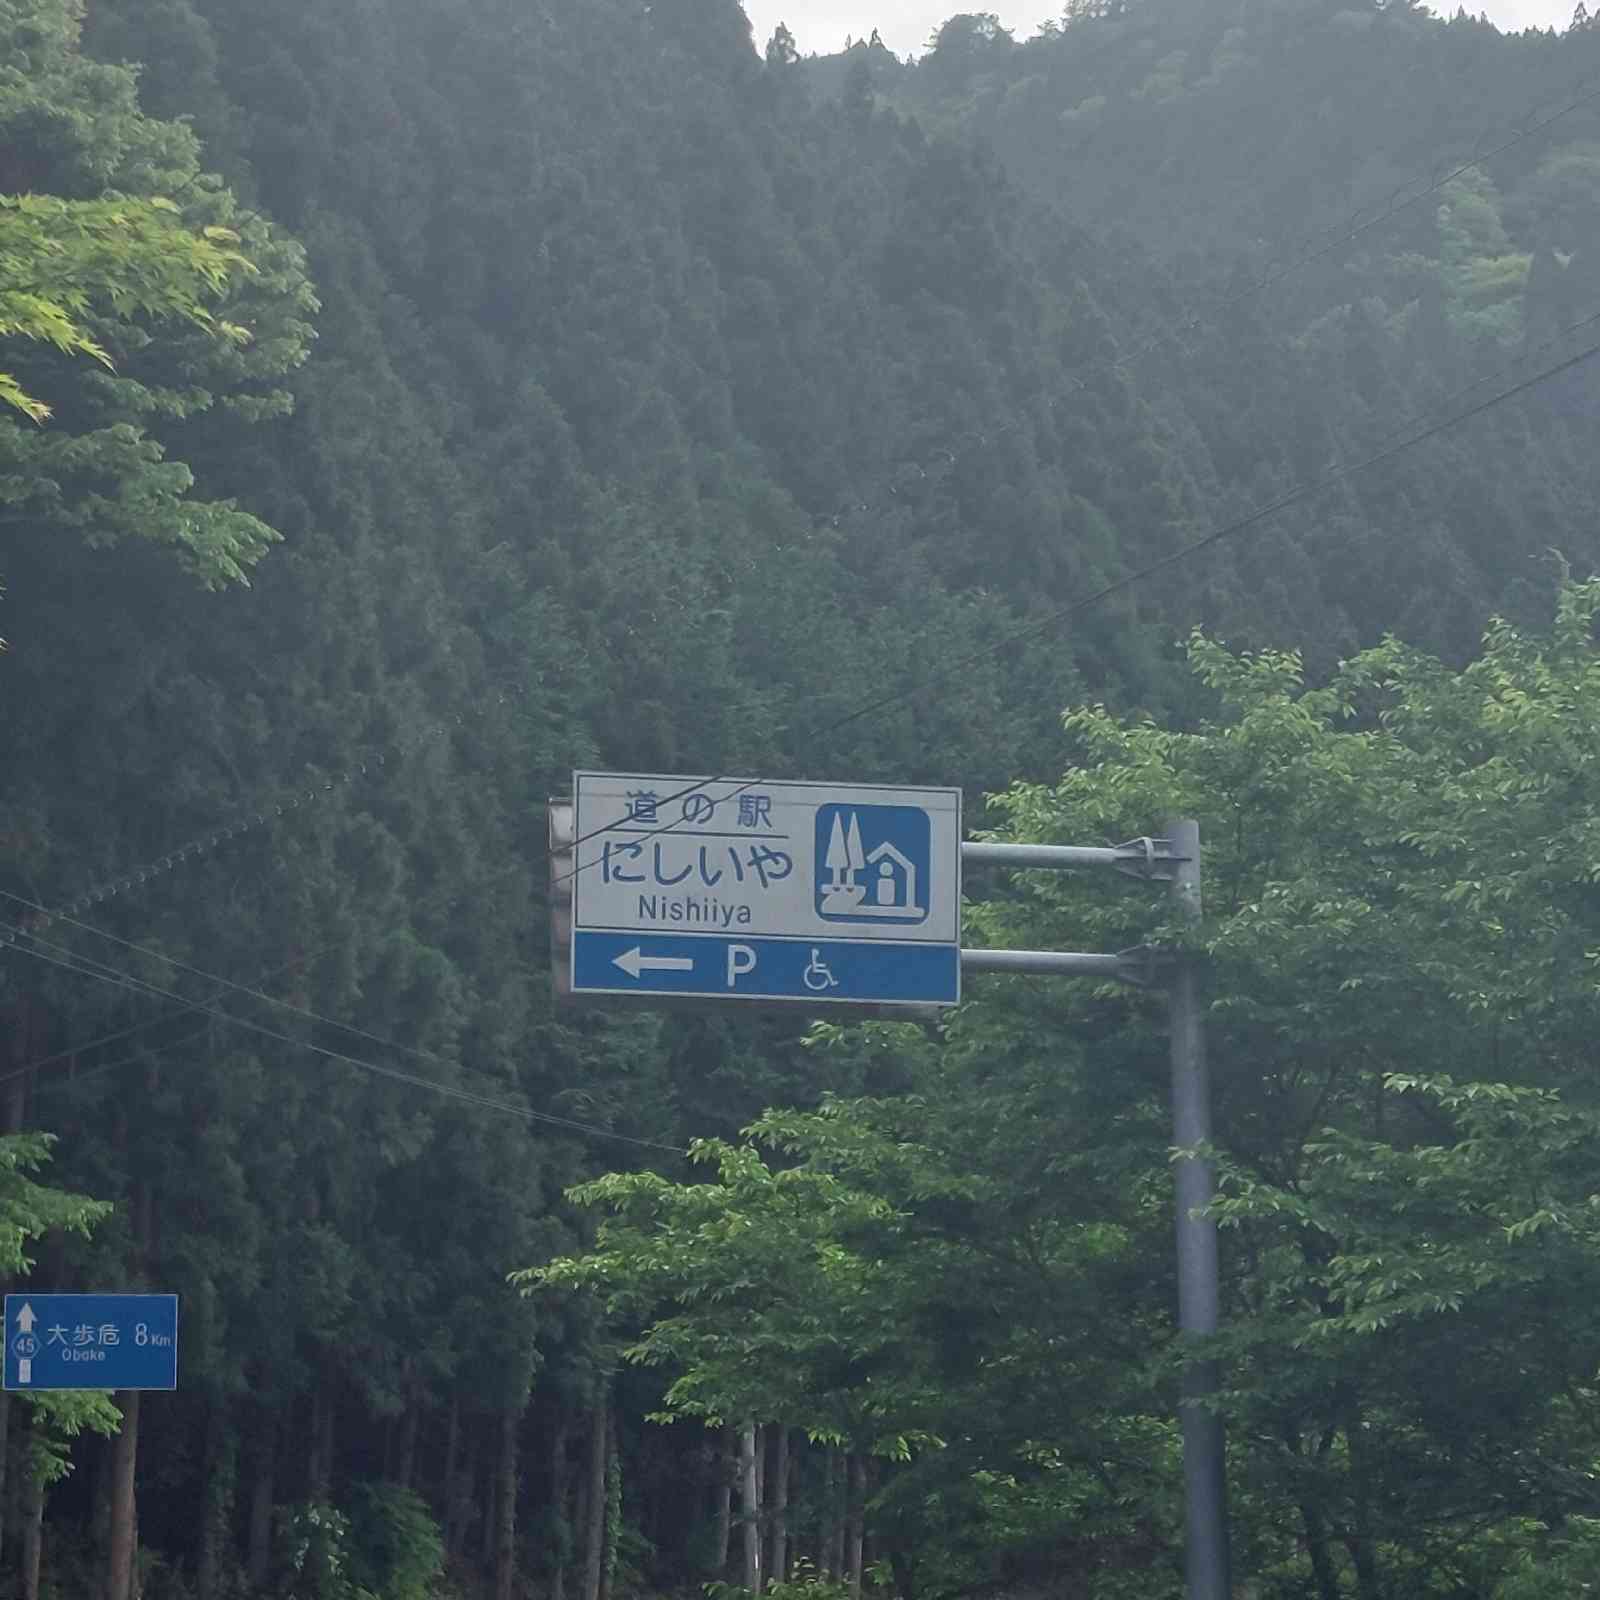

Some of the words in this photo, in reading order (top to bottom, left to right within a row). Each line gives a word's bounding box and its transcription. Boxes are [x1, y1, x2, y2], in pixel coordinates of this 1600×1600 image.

[624, 790, 772, 828] 道の駅
[602, 841, 793, 888] にしいや
[639, 895, 751, 928] Nishiiya
[727, 944, 757, 987] P
[17, 1337, 35, 1353] 45
[47, 1323, 120, 1346] 大歩危
